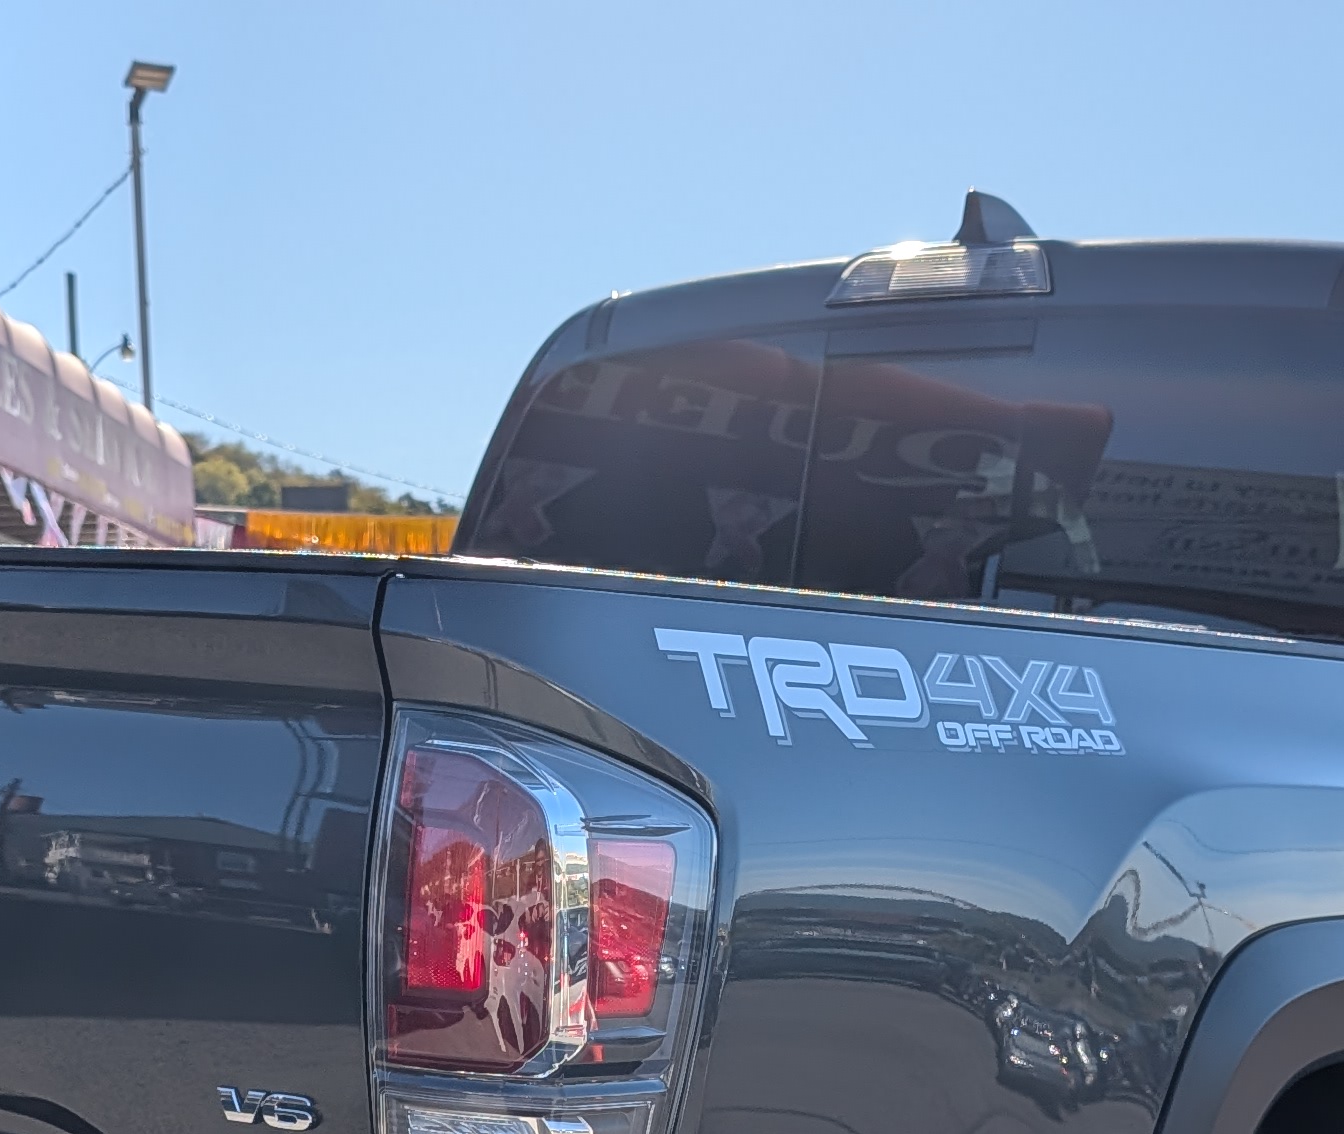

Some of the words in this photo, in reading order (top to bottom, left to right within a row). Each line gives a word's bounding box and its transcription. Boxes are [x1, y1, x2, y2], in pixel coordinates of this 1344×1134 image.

[654, 627, 928, 746] TRD
[923, 651, 1117, 727] 4X4
[937, 720, 1019, 753] OFF
[1019, 725, 1126, 756] ROAD
[216, 1085, 316, 1131] V6
